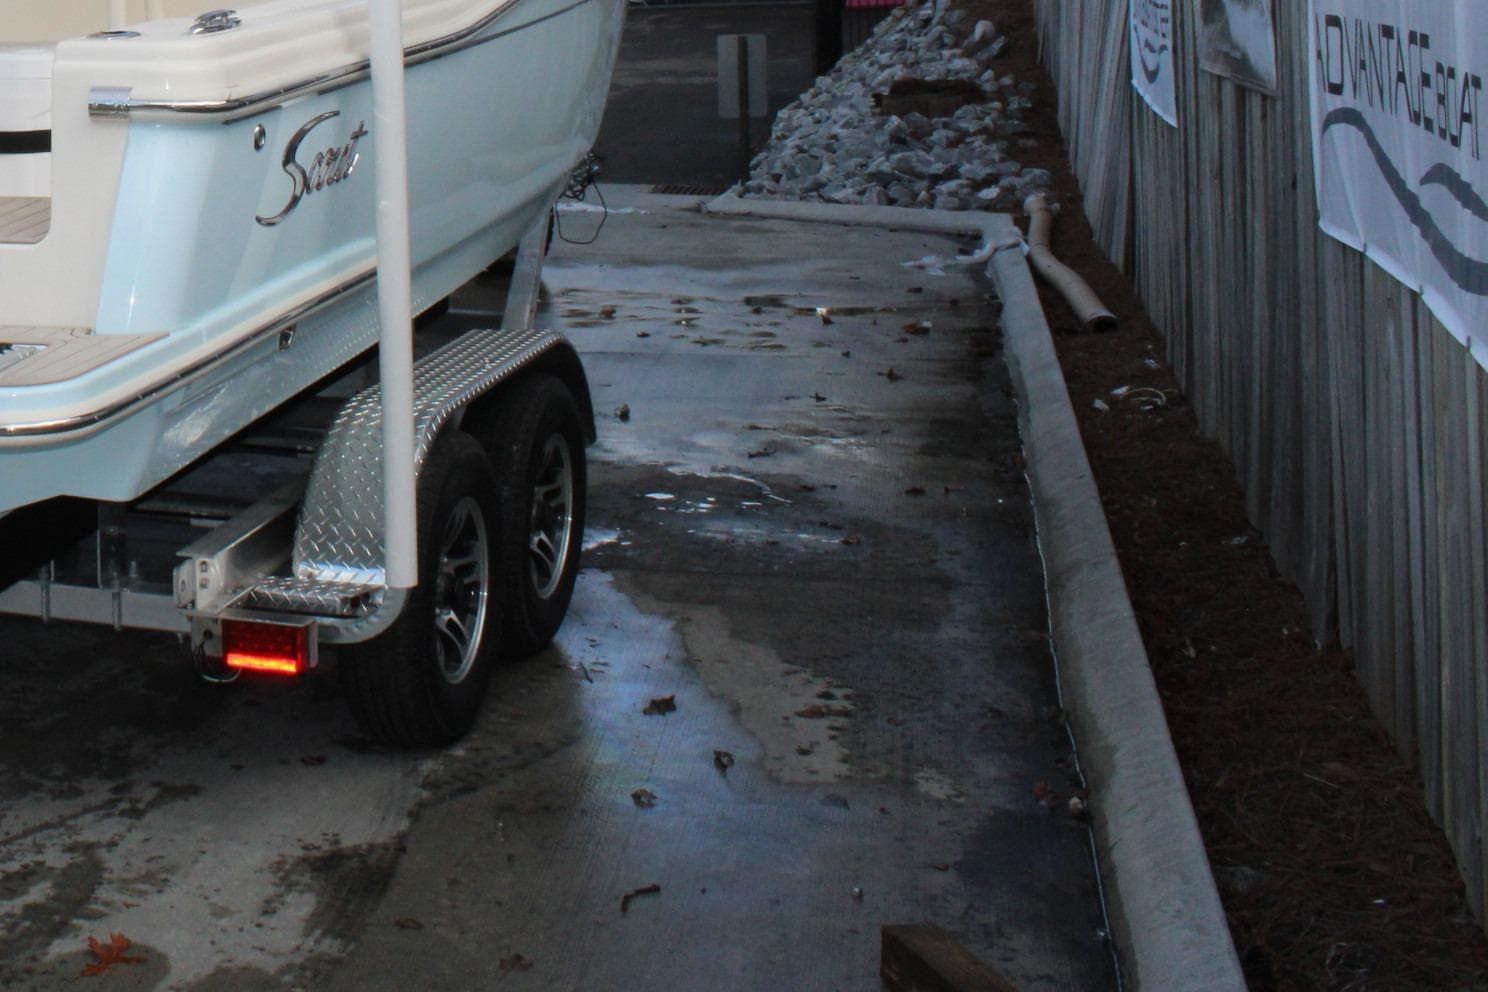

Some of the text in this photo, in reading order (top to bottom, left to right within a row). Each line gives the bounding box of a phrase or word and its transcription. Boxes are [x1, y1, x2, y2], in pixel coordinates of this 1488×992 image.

[1315, 12, 1482, 161] ADVANTAGE BOAT
[255, 110, 368, 226] Scout
